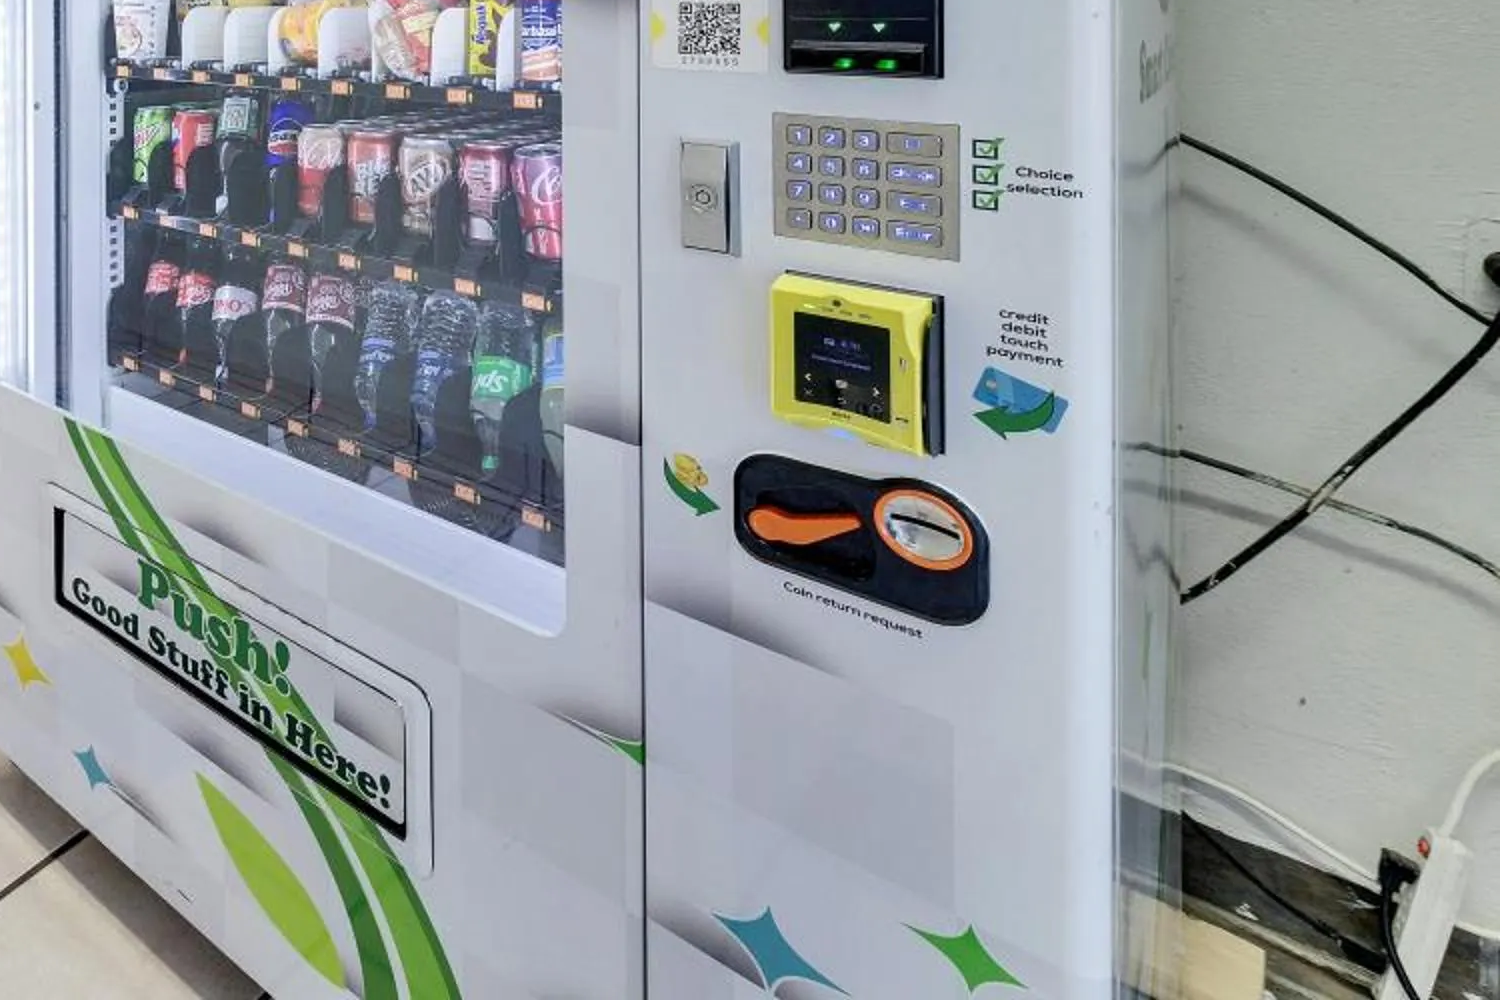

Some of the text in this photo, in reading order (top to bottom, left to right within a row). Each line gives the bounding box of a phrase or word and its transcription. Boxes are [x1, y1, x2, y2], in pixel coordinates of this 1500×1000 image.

[1015, 165, 1075, 184] Choice
[1006, 181, 1084, 200] selection
[999, 307, 1050, 325] credit
[1001, 320, 1048, 338] debit
[999, 333, 1049, 352] touch
[986, 345, 1066, 369] payment
[782, 580, 924, 639] Coin return request
[136, 557, 291, 696] Push!
[72, 577, 392, 809] Good Stuff in Here!
